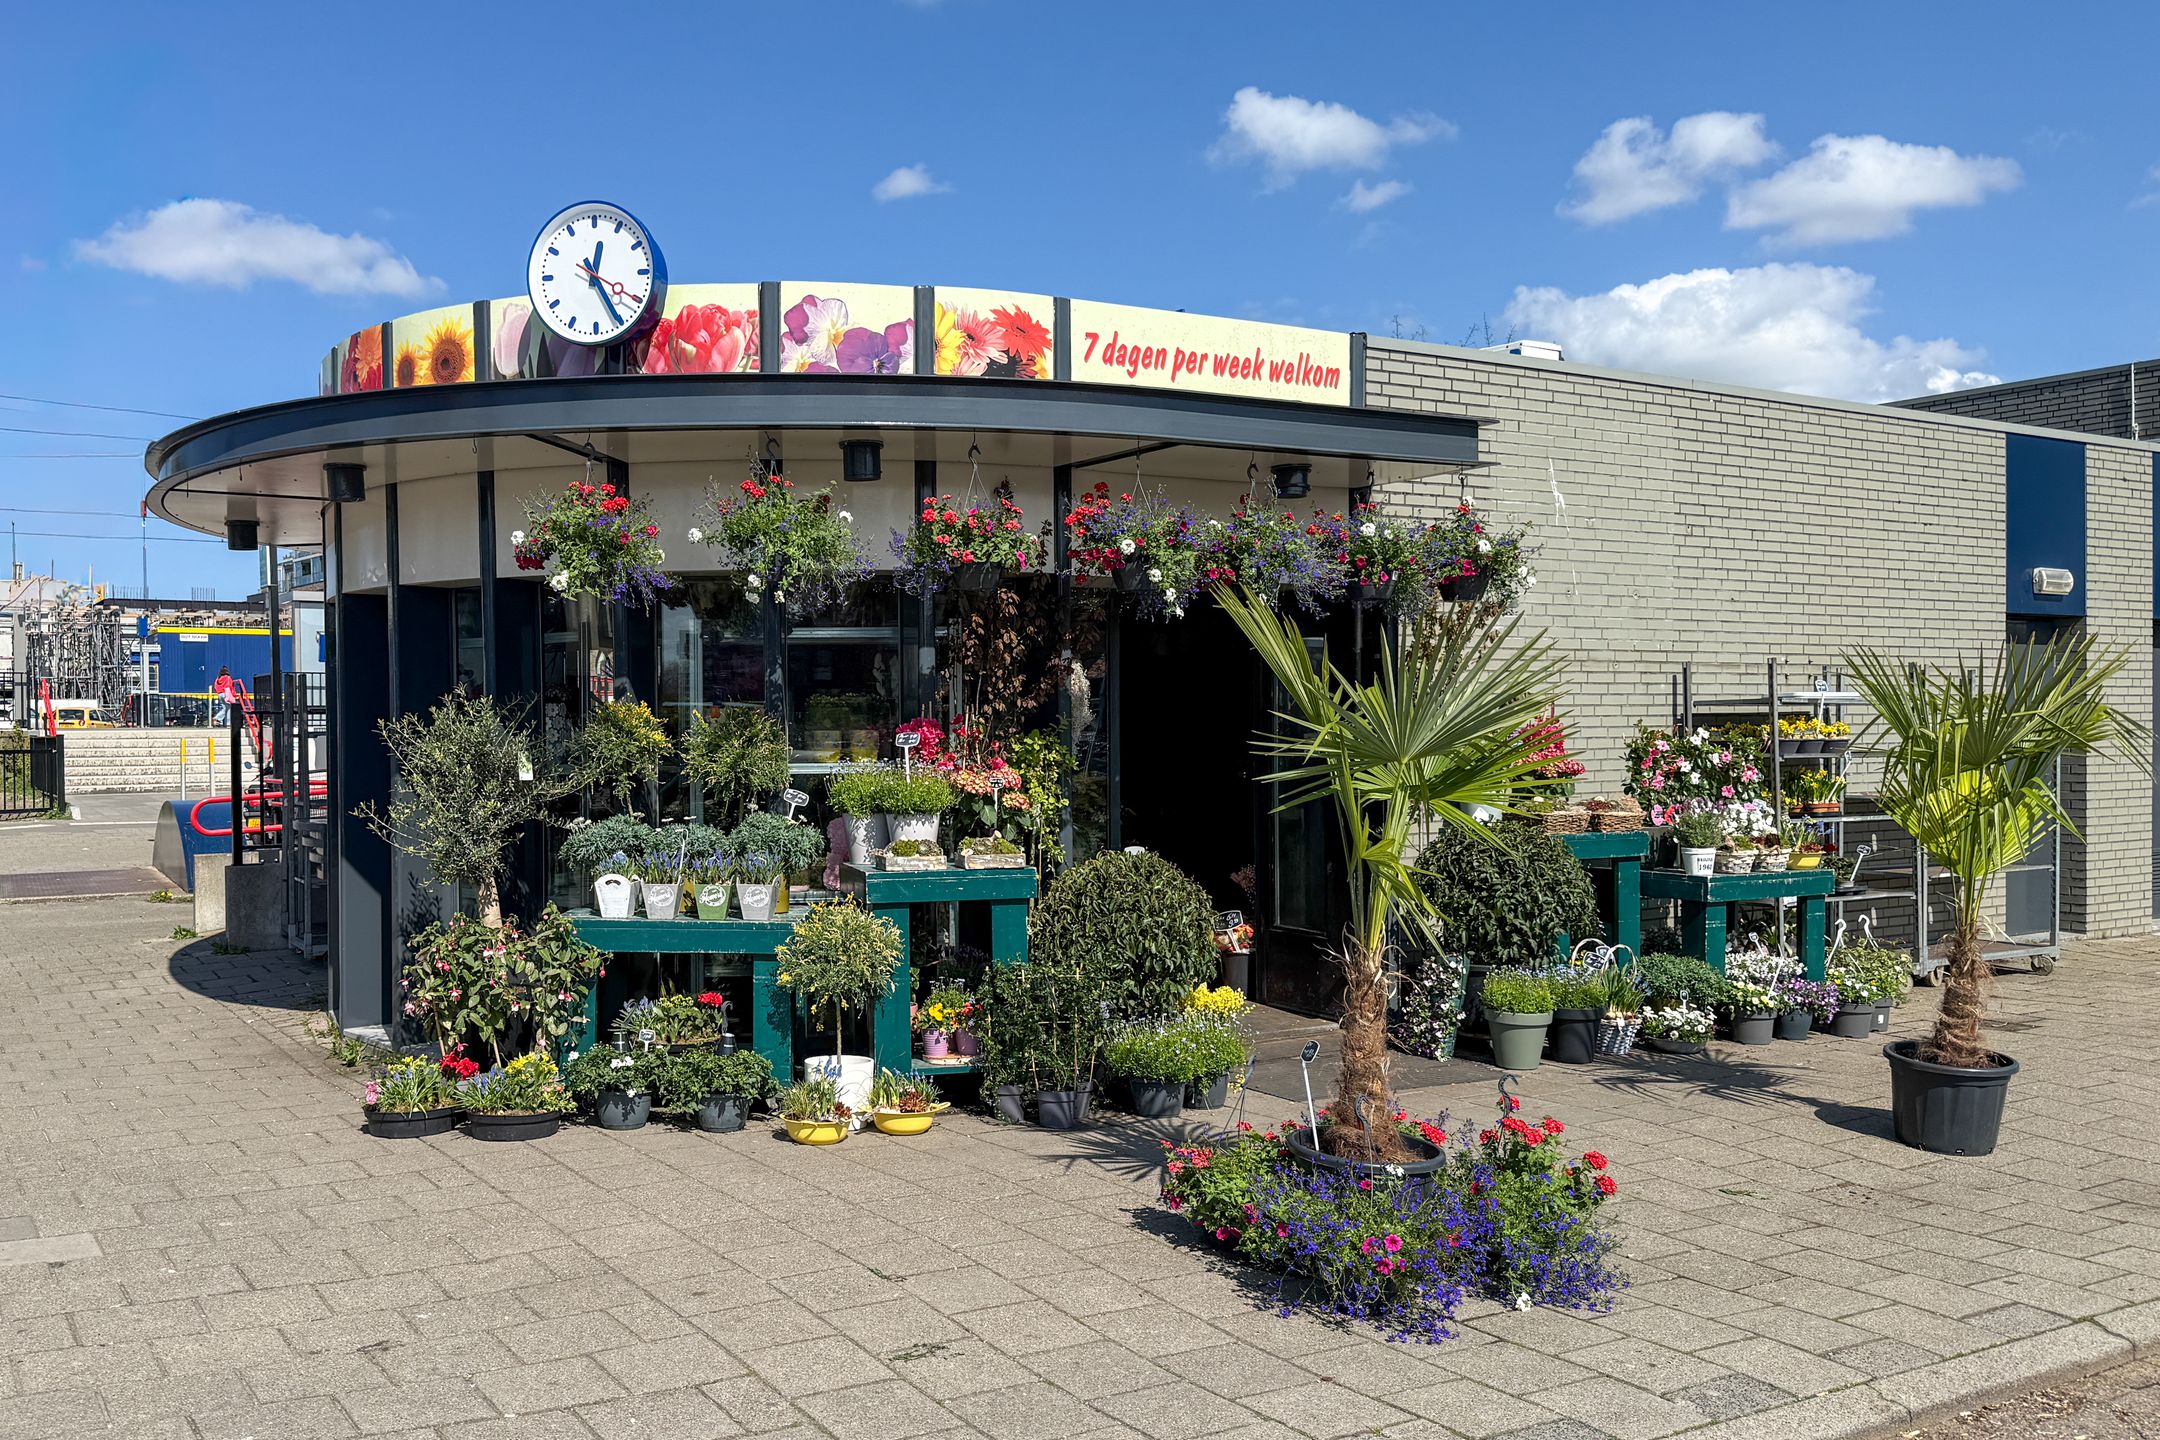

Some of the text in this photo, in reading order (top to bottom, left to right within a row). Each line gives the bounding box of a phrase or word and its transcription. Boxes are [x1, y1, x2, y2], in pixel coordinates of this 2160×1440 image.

[1084, 331, 1341, 389] 7 dagen per week welkom
